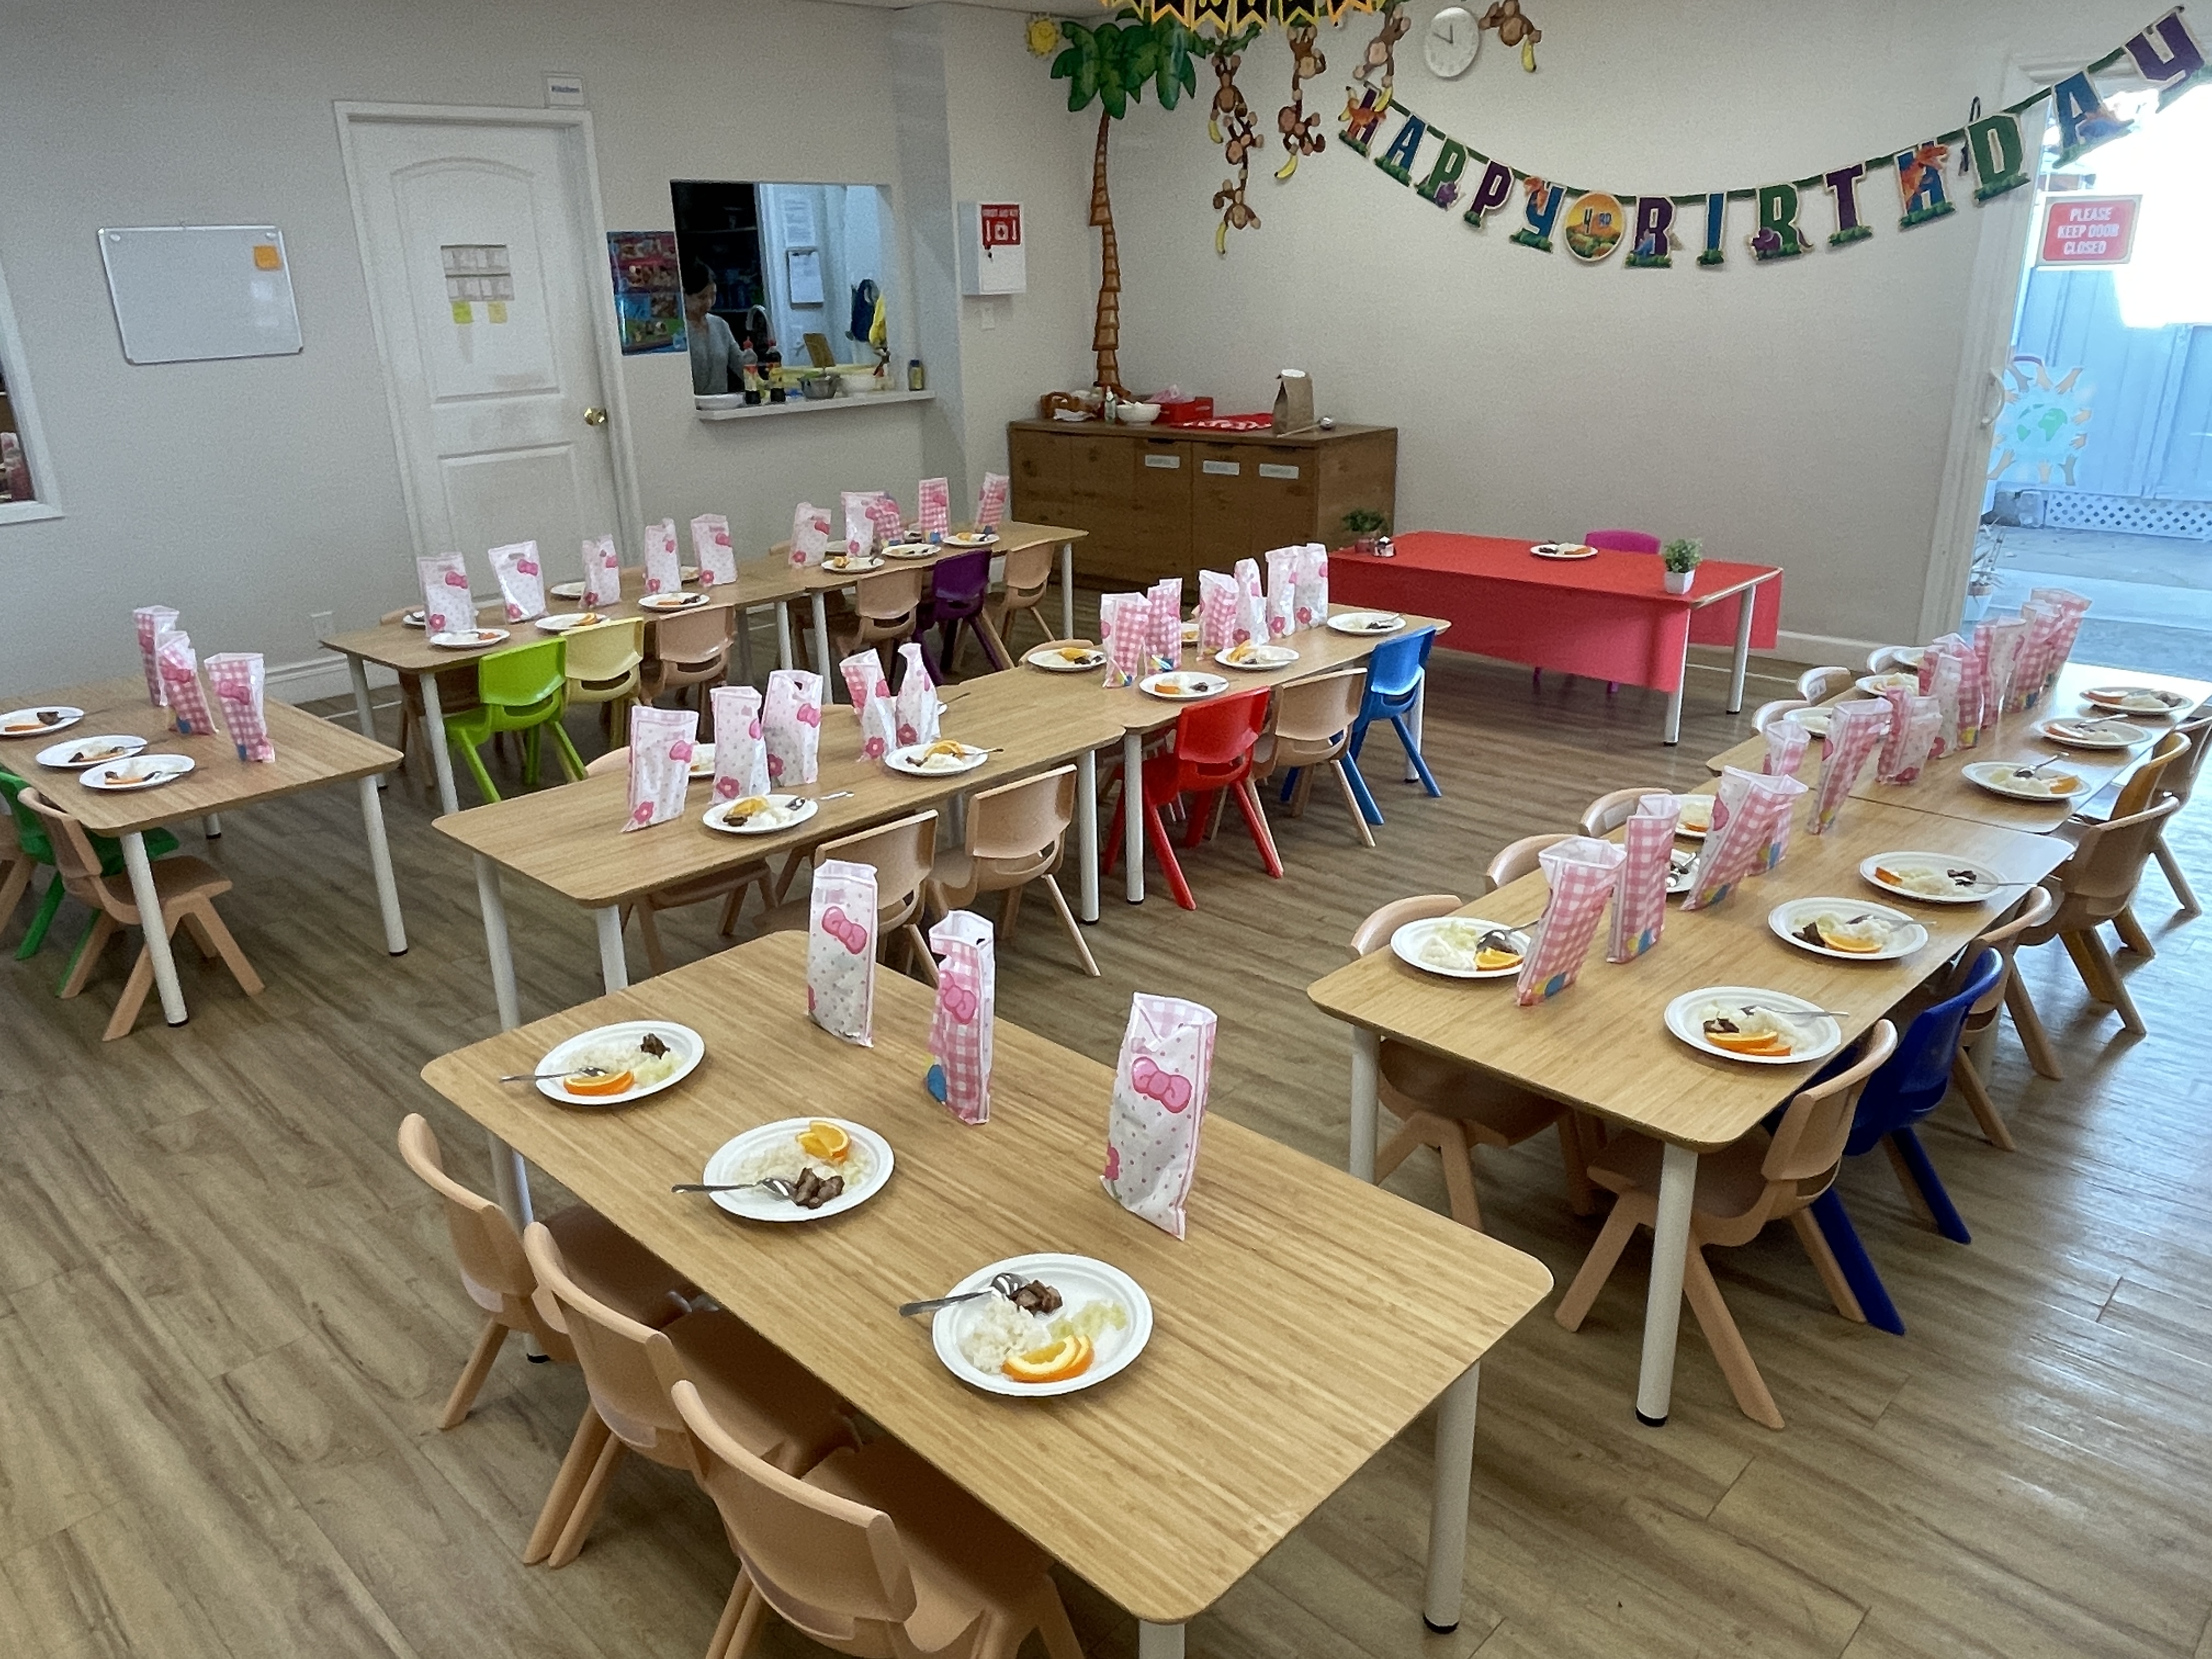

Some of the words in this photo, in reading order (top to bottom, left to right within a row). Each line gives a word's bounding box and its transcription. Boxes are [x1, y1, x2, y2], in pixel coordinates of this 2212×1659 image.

[1339, 85, 1568, 252] HAPPY
[1627, 11, 2207, 268] BIRTHDAY
[2069, 206, 2114, 222] PLEASE
[2057, 225, 2087, 239] KEEP
[2088, 224, 2120, 238] DOOR
[2063, 240, 2107, 255] CLOSED
